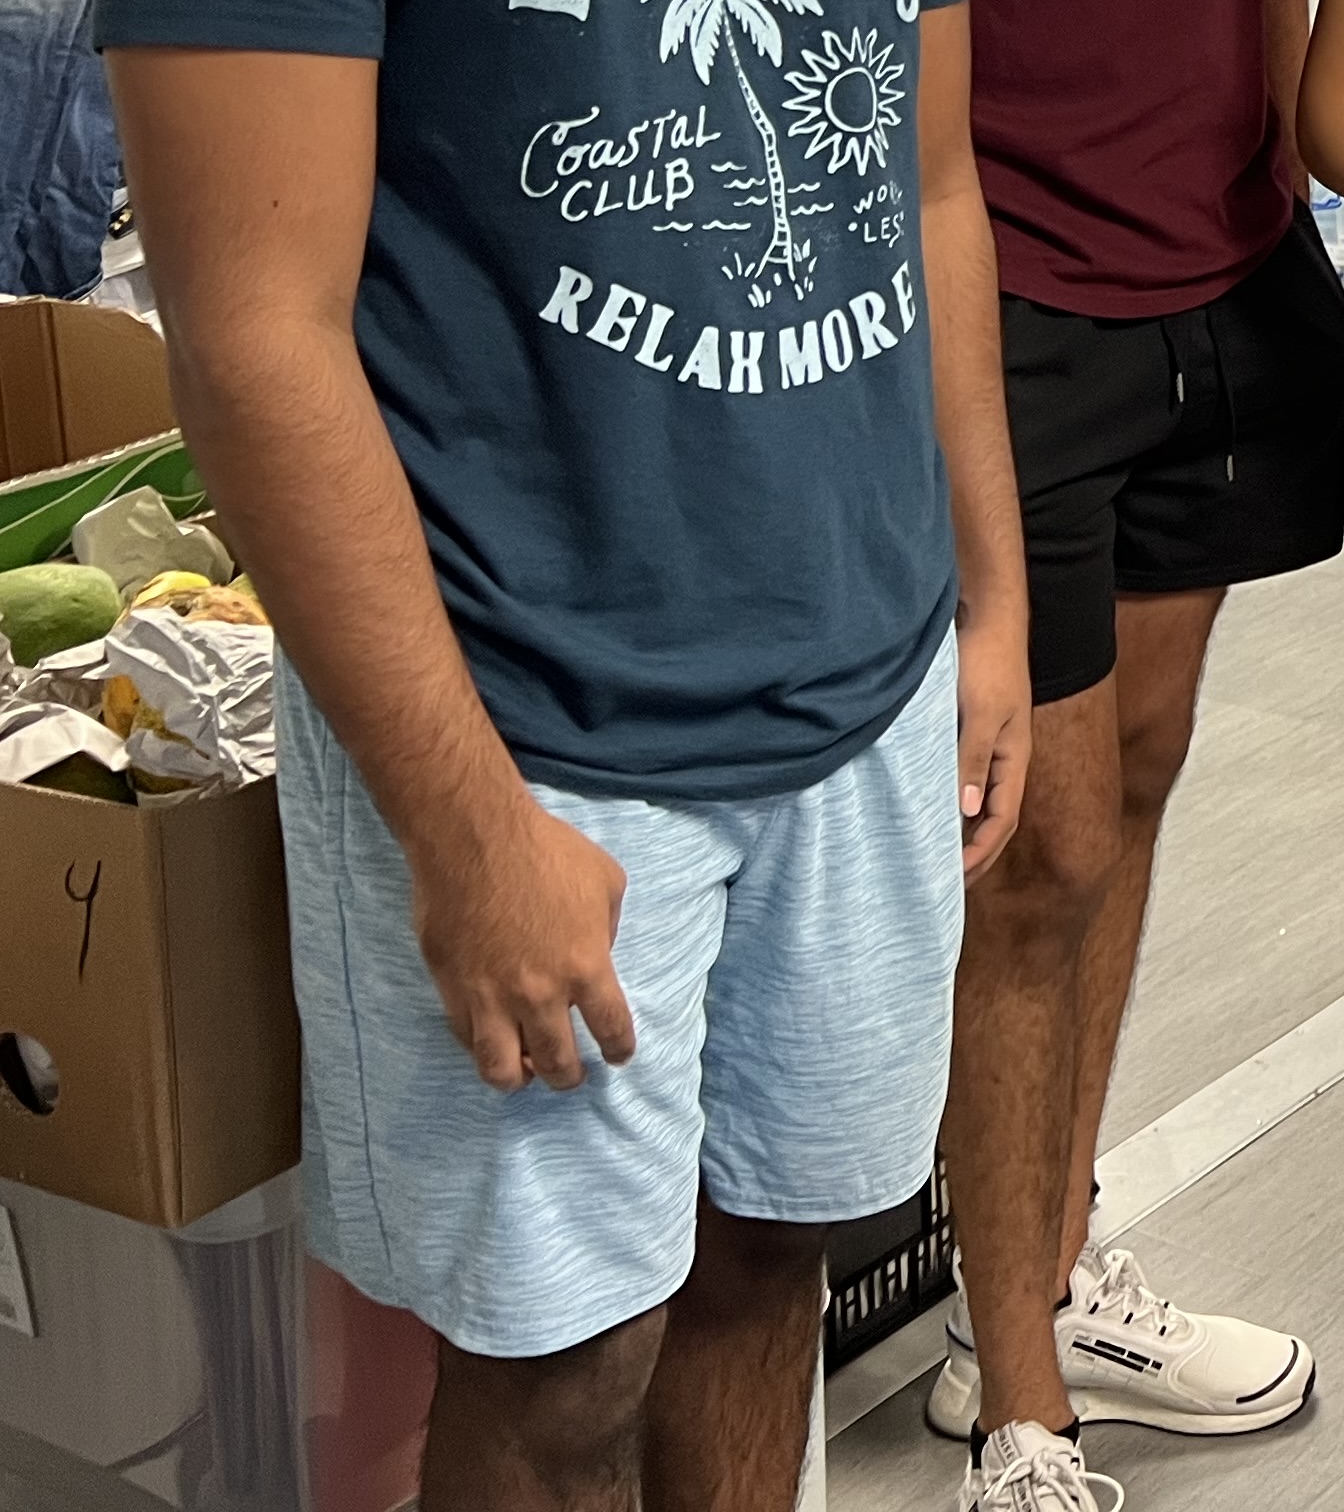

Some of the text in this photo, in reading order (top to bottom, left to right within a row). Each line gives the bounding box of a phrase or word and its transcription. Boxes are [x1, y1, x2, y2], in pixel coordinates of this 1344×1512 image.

[560, 163, 696, 223] CLUB
[537, 259, 917, 395] RELAX MORE
